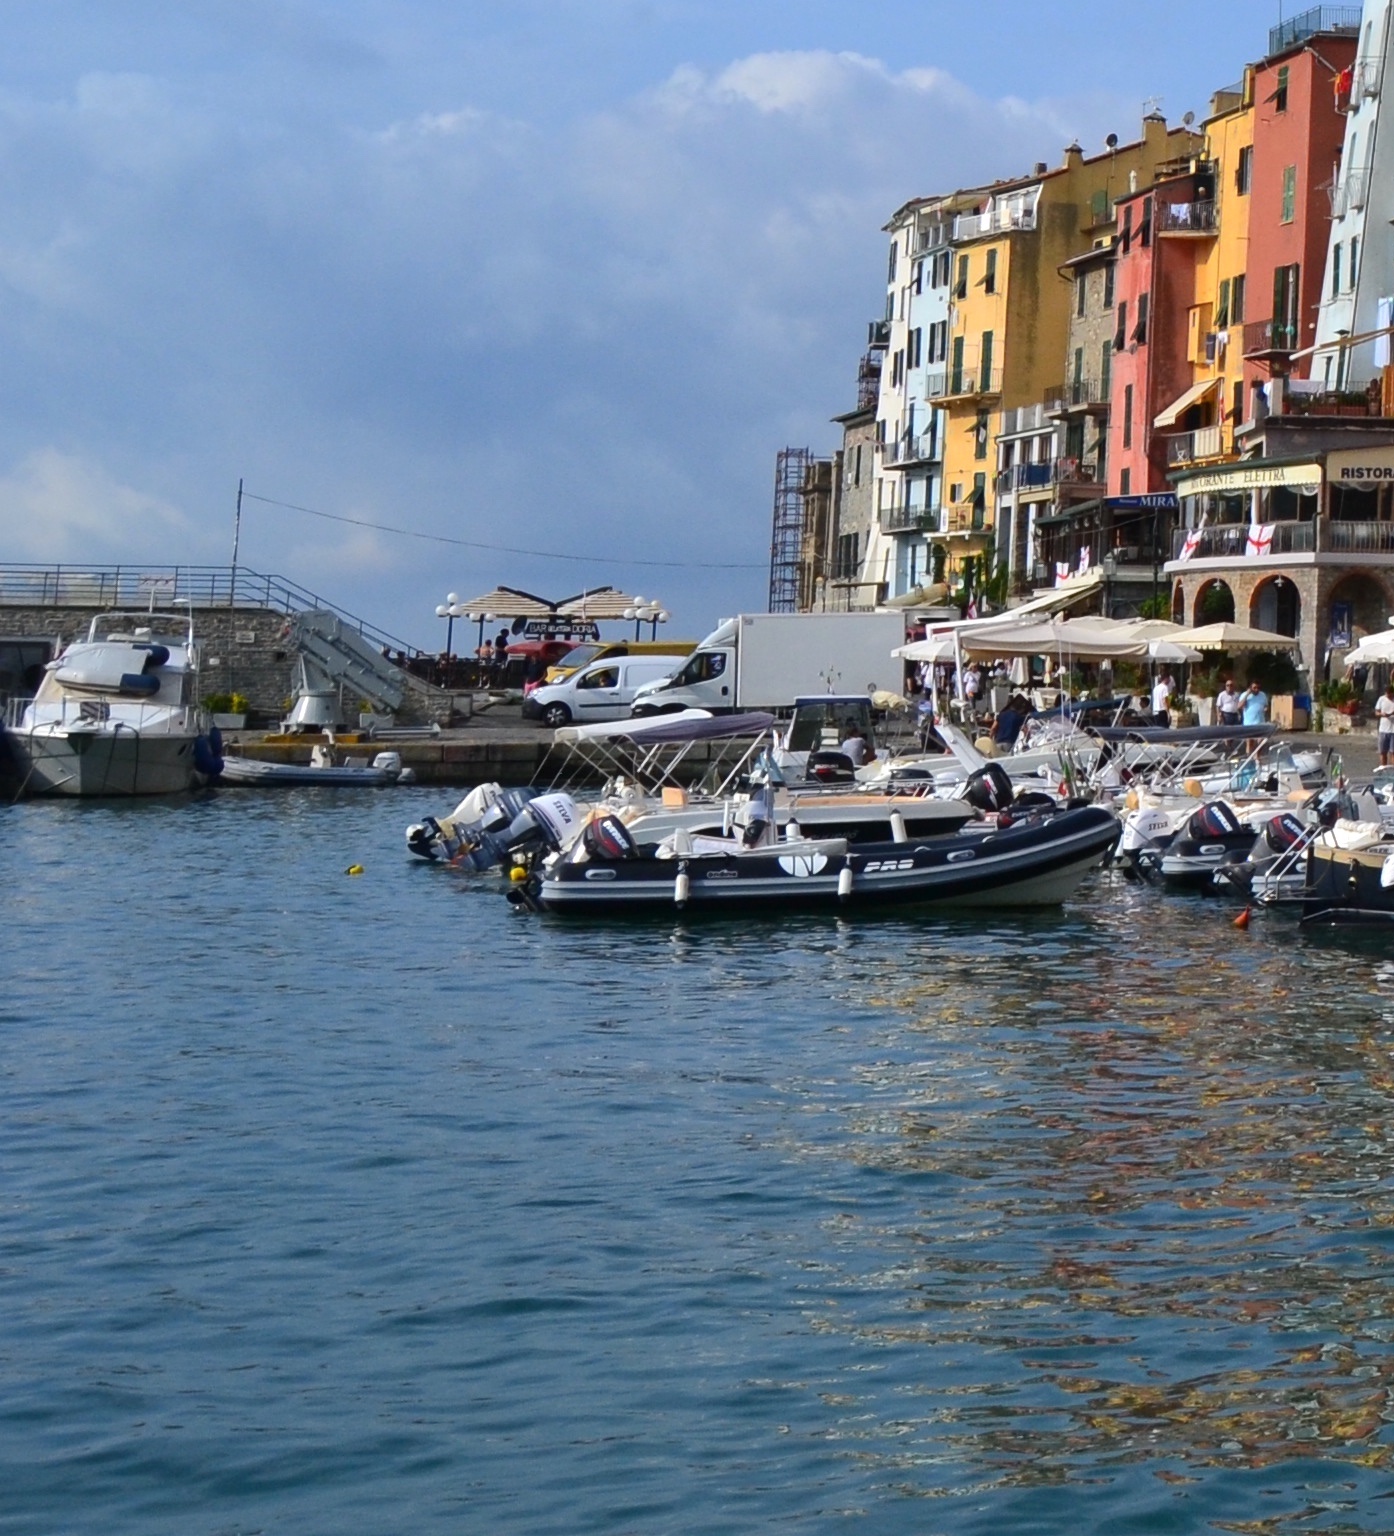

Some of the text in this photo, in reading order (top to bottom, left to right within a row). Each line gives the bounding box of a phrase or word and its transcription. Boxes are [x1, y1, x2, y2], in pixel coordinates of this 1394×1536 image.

[1244, 468, 1285, 483] ELETTRA
[529, 624, 547, 633] BAR
[572, 624, 597, 633] DORIA
[552, 800, 572, 824] SELVA
